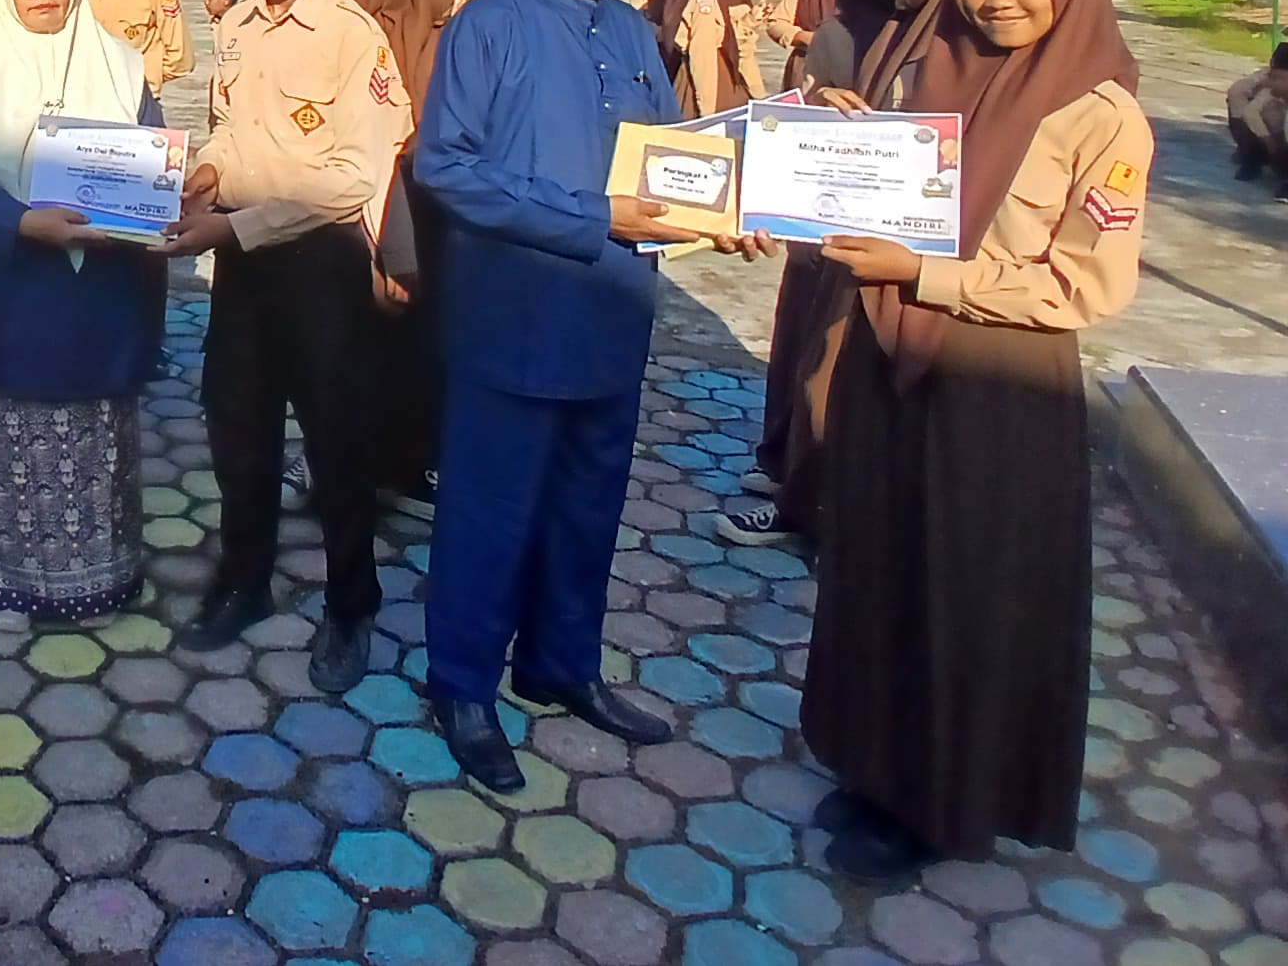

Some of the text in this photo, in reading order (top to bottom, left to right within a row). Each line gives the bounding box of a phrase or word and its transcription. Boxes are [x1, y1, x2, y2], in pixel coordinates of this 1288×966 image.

[799, 143, 825, 153] Mitha
[874, 149, 900, 159] Putri
[124, 204, 166, 214] MANDIRI
[881, 219, 943, 231] MANDIRI
